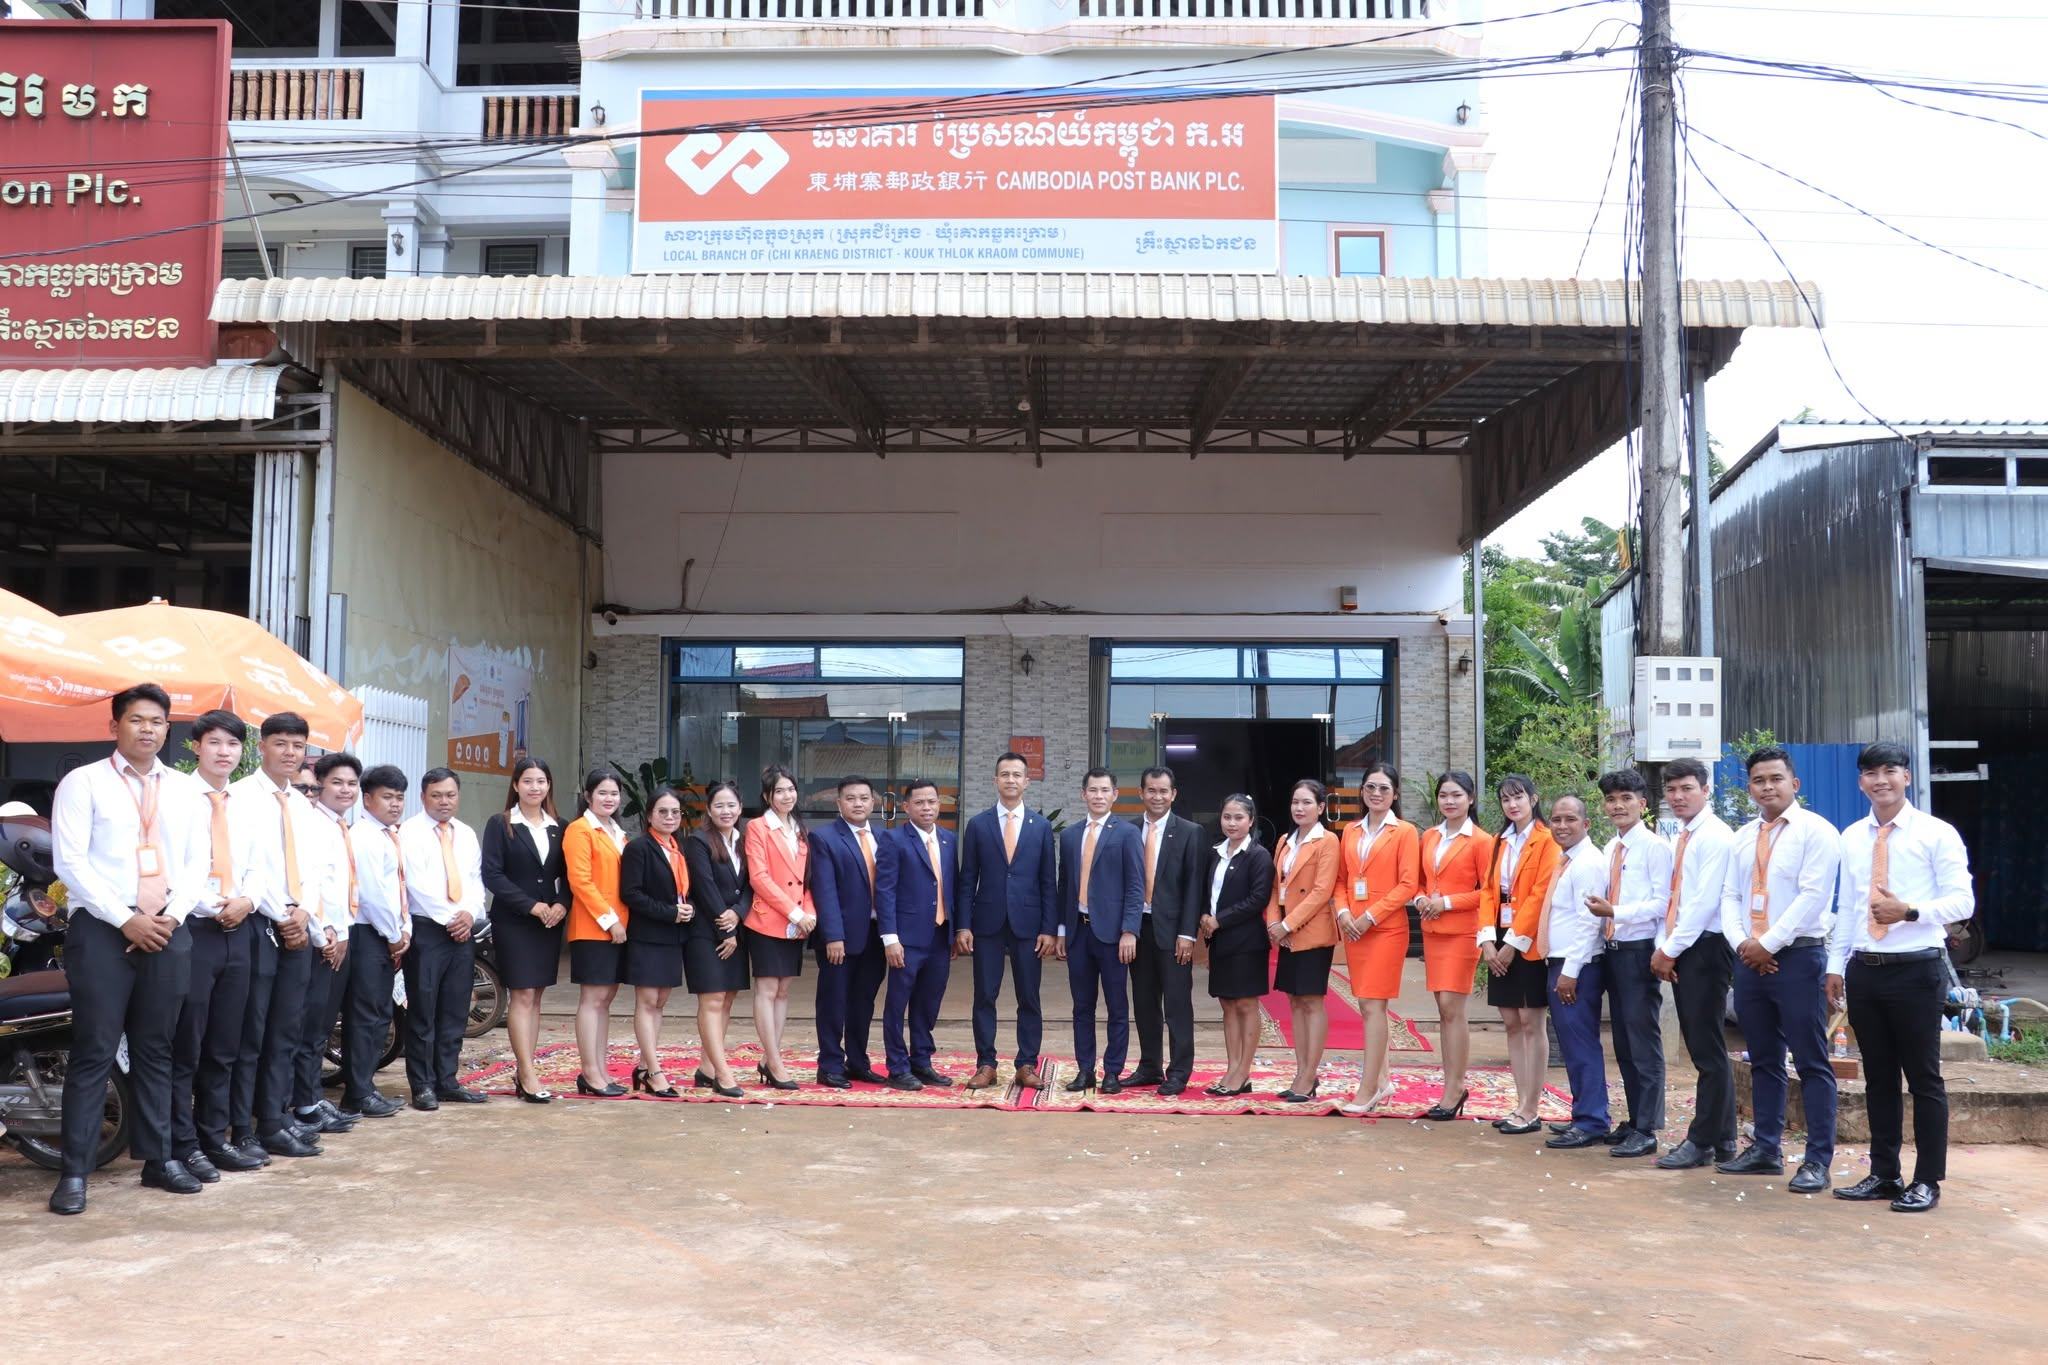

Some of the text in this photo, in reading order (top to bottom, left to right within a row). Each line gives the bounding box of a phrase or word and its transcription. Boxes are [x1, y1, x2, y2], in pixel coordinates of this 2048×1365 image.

[811, 123, 919, 149] ធនាគារ
[1185, 122, 1245, 147] ក.អ
[66, 173, 142, 205] Plc.
[996, 171, 1094, 191] CAMBODIA
[1098, 171, 1146, 191] POST
[1150, 171, 1202, 191] BANK
[1205, 171, 1245, 192] PLC.
[664, 250, 699, 262] LOCAL
[702, 249, 747, 262] BRANCH
[750, 249, 765, 261] OF
[768, 249, 791, 262] (CHI
[794, 249, 839, 260] KRAENG
[843, 248, 894, 260] DISTRICT
[904, 247, 935, 260] KOUK
[937, 247, 974, 260] THLOK
[977, 247, 1018, 260] KRAOM
[1022, 247, 1085, 261] COMMUNE)
